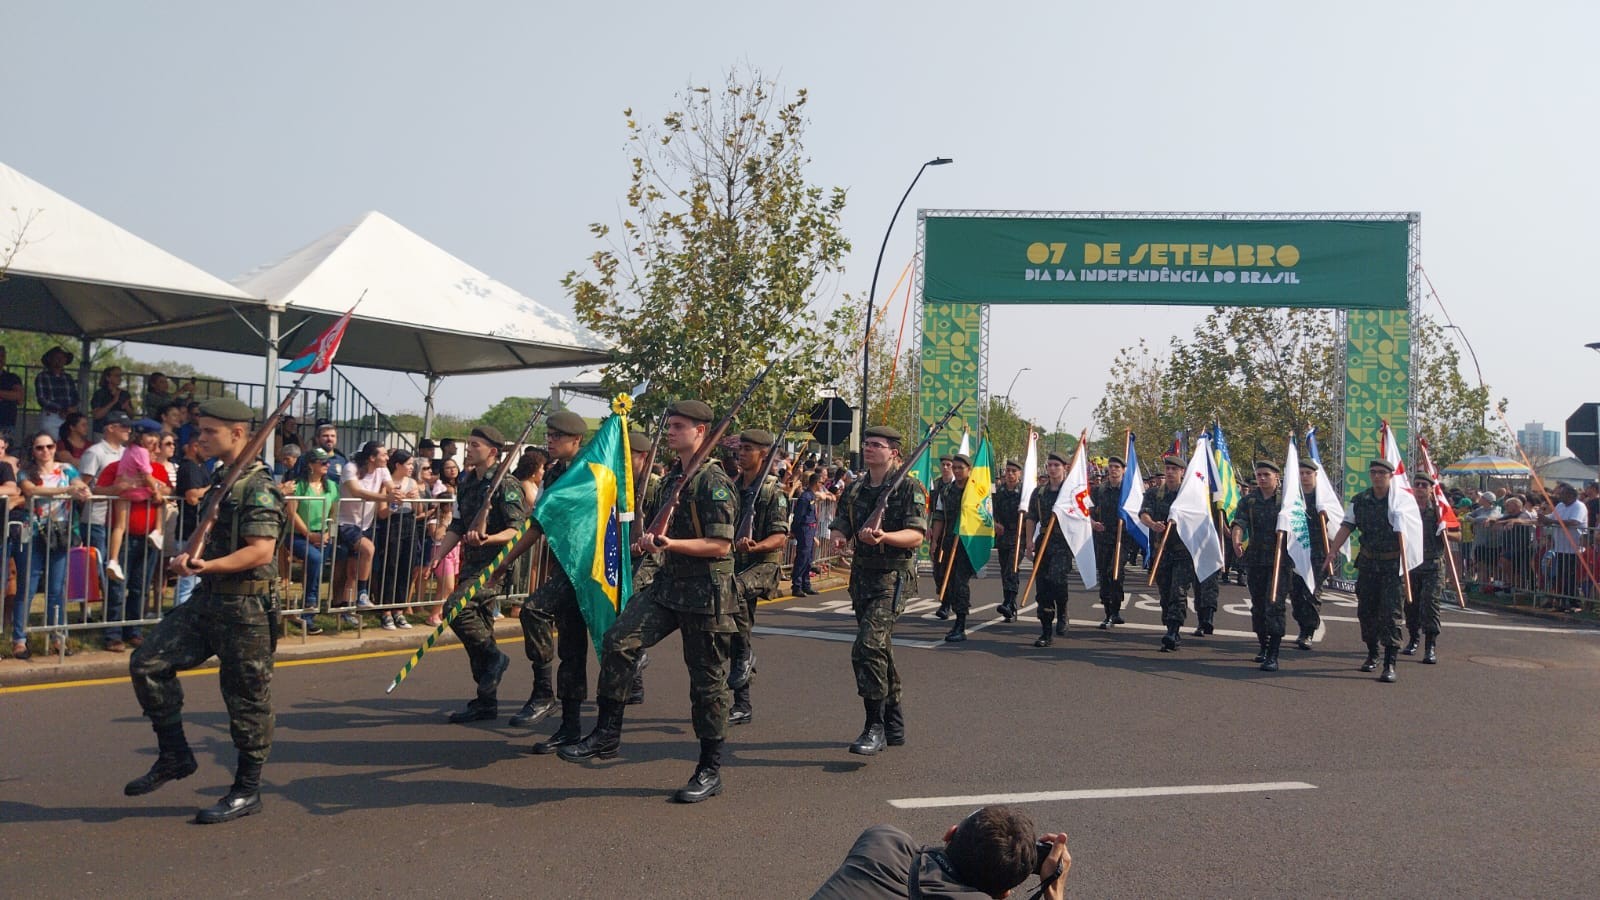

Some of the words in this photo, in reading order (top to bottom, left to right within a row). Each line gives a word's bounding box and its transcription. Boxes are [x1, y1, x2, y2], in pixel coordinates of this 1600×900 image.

[1026, 242, 1067, 265] 07
[1084, 243, 1121, 265] DE
[1129, 243, 1300, 268] SETEMBRO
[1025, 268, 1052, 281] DIA
[1056, 269, 1077, 281] DA
[1080, 266, 1210, 283] INDEPENDÊNCIA
[1213, 271, 1236, 284] DO
[1240, 271, 1300, 284] BRASIL
